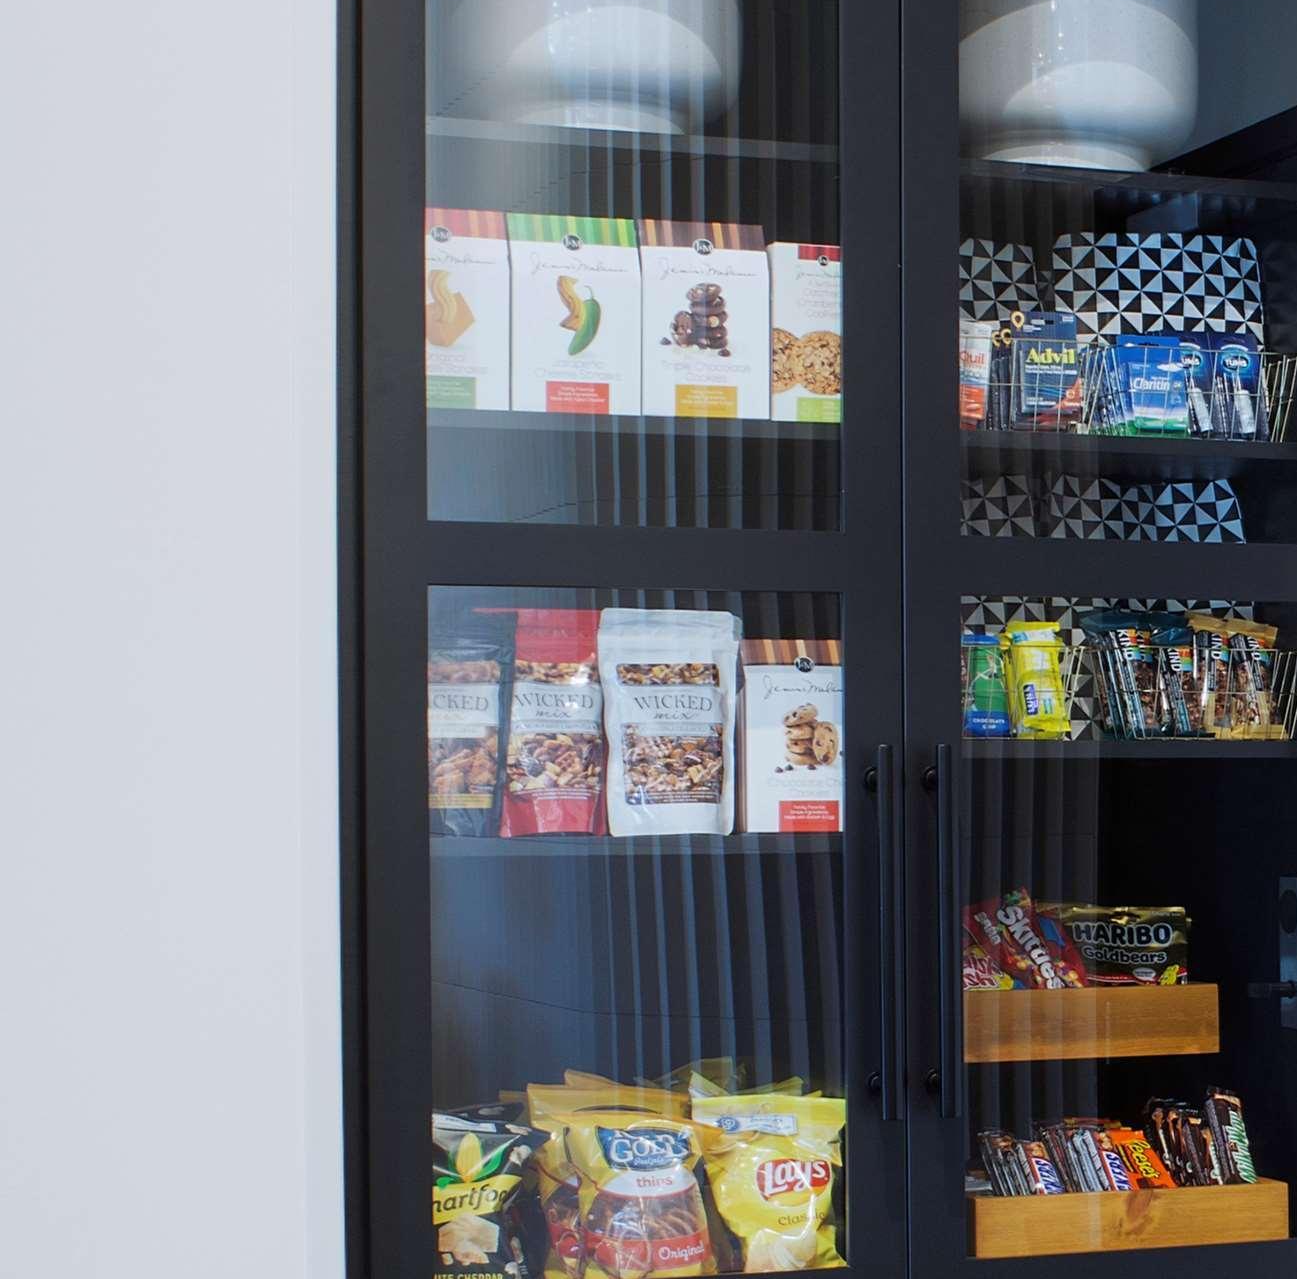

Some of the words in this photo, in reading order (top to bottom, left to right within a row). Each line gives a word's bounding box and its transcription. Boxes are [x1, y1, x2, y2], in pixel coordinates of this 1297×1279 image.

[1025, 347, 1076, 364] Advil
[1133, 378, 1170, 392] Claritin
[514, 693, 594, 709] WICKED
[634, 694, 713, 712] WICKED
[1073, 921, 1173, 948] HARIBO
[1082, 945, 1168, 964] Goldbears
